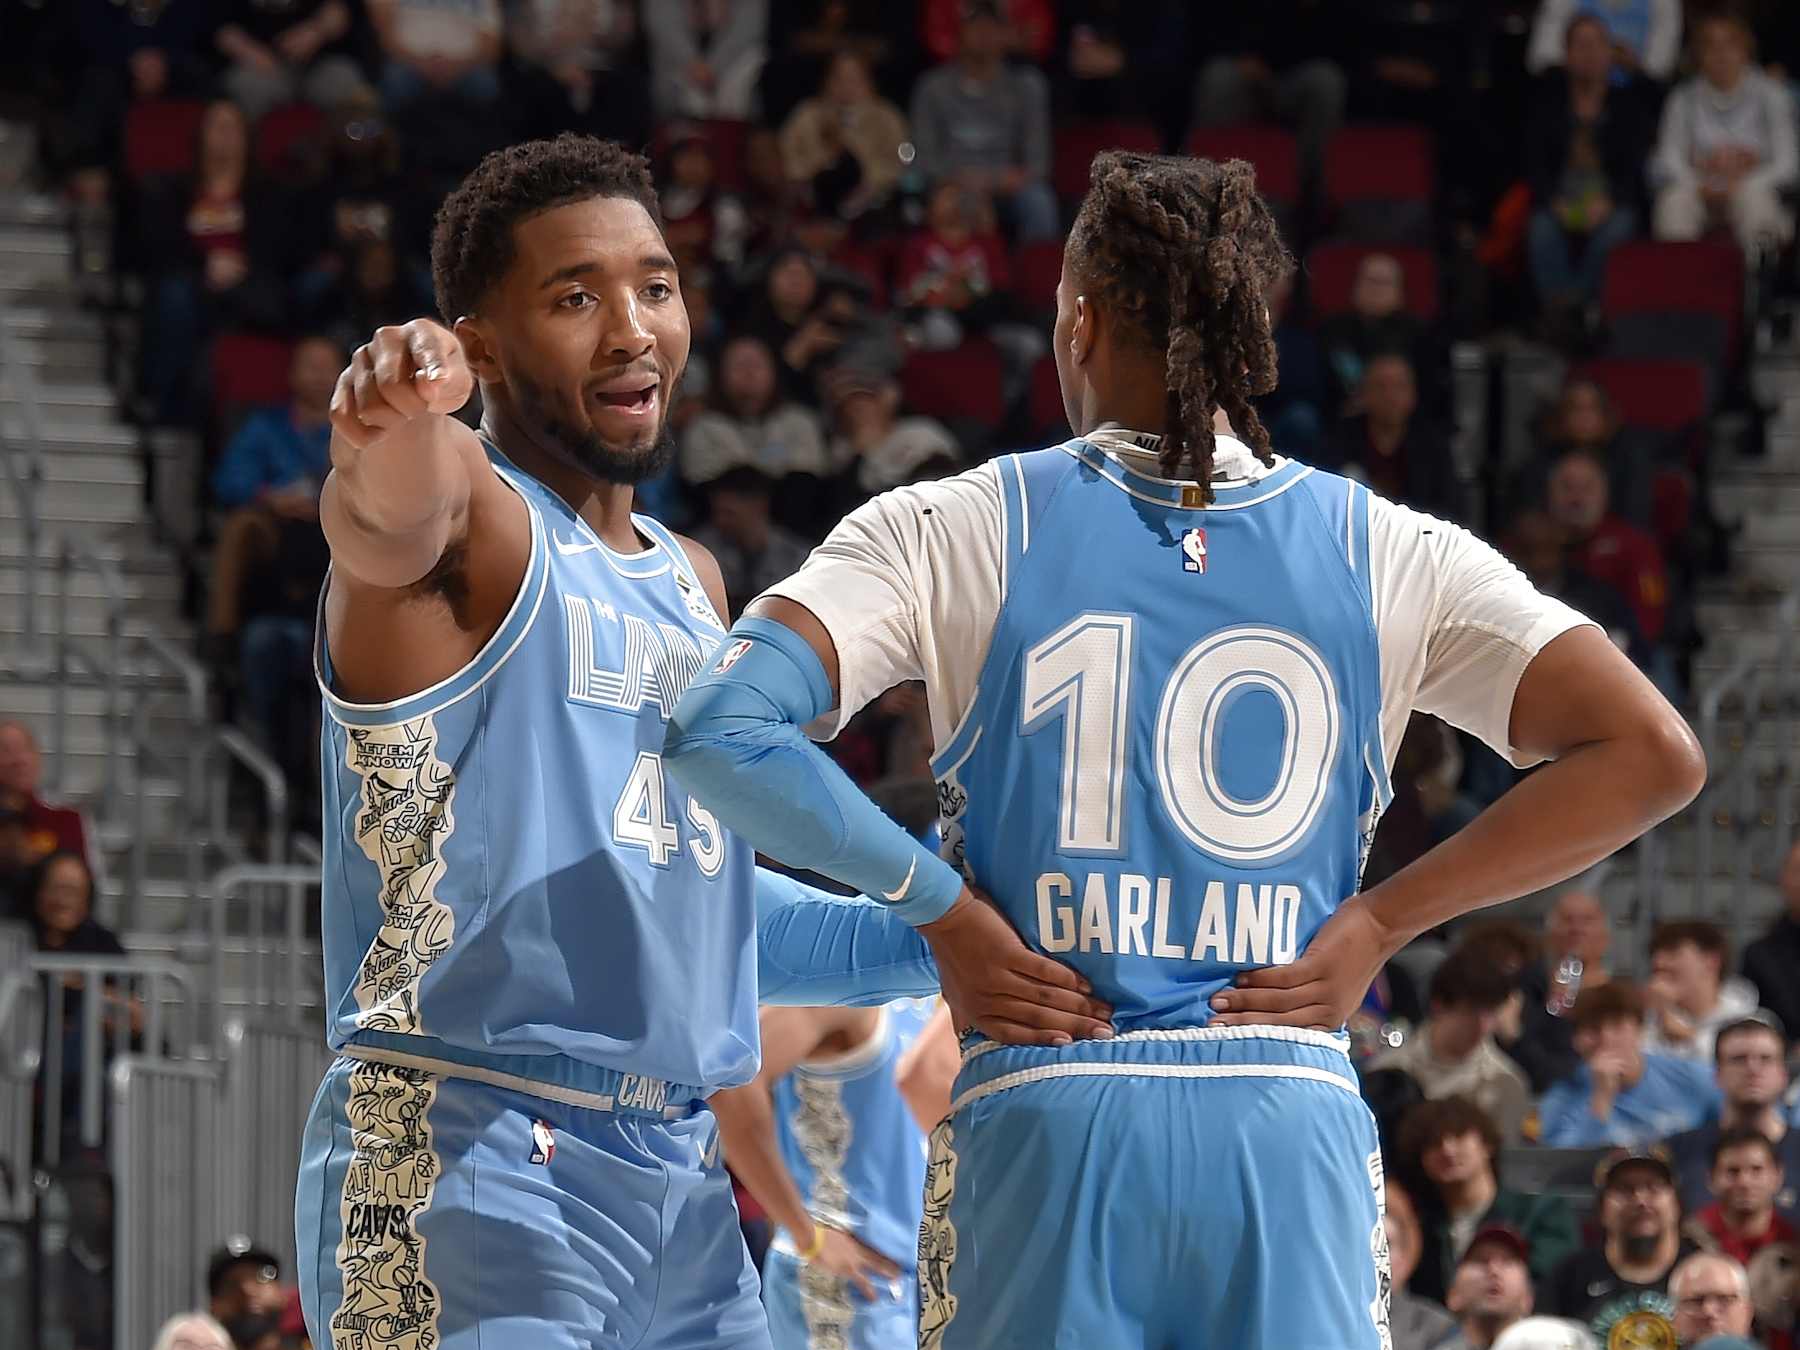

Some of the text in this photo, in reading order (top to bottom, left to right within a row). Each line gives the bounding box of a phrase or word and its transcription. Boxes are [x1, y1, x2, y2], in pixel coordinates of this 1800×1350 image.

[563, 592, 722, 719] LAN
[357, 756, 413, 769] KNOW
[387, 744, 414, 756] EM
[1021, 610, 1338, 866] 10
[612, 750, 726, 882] 45
[1036, 871, 1302, 966] GARLAND
